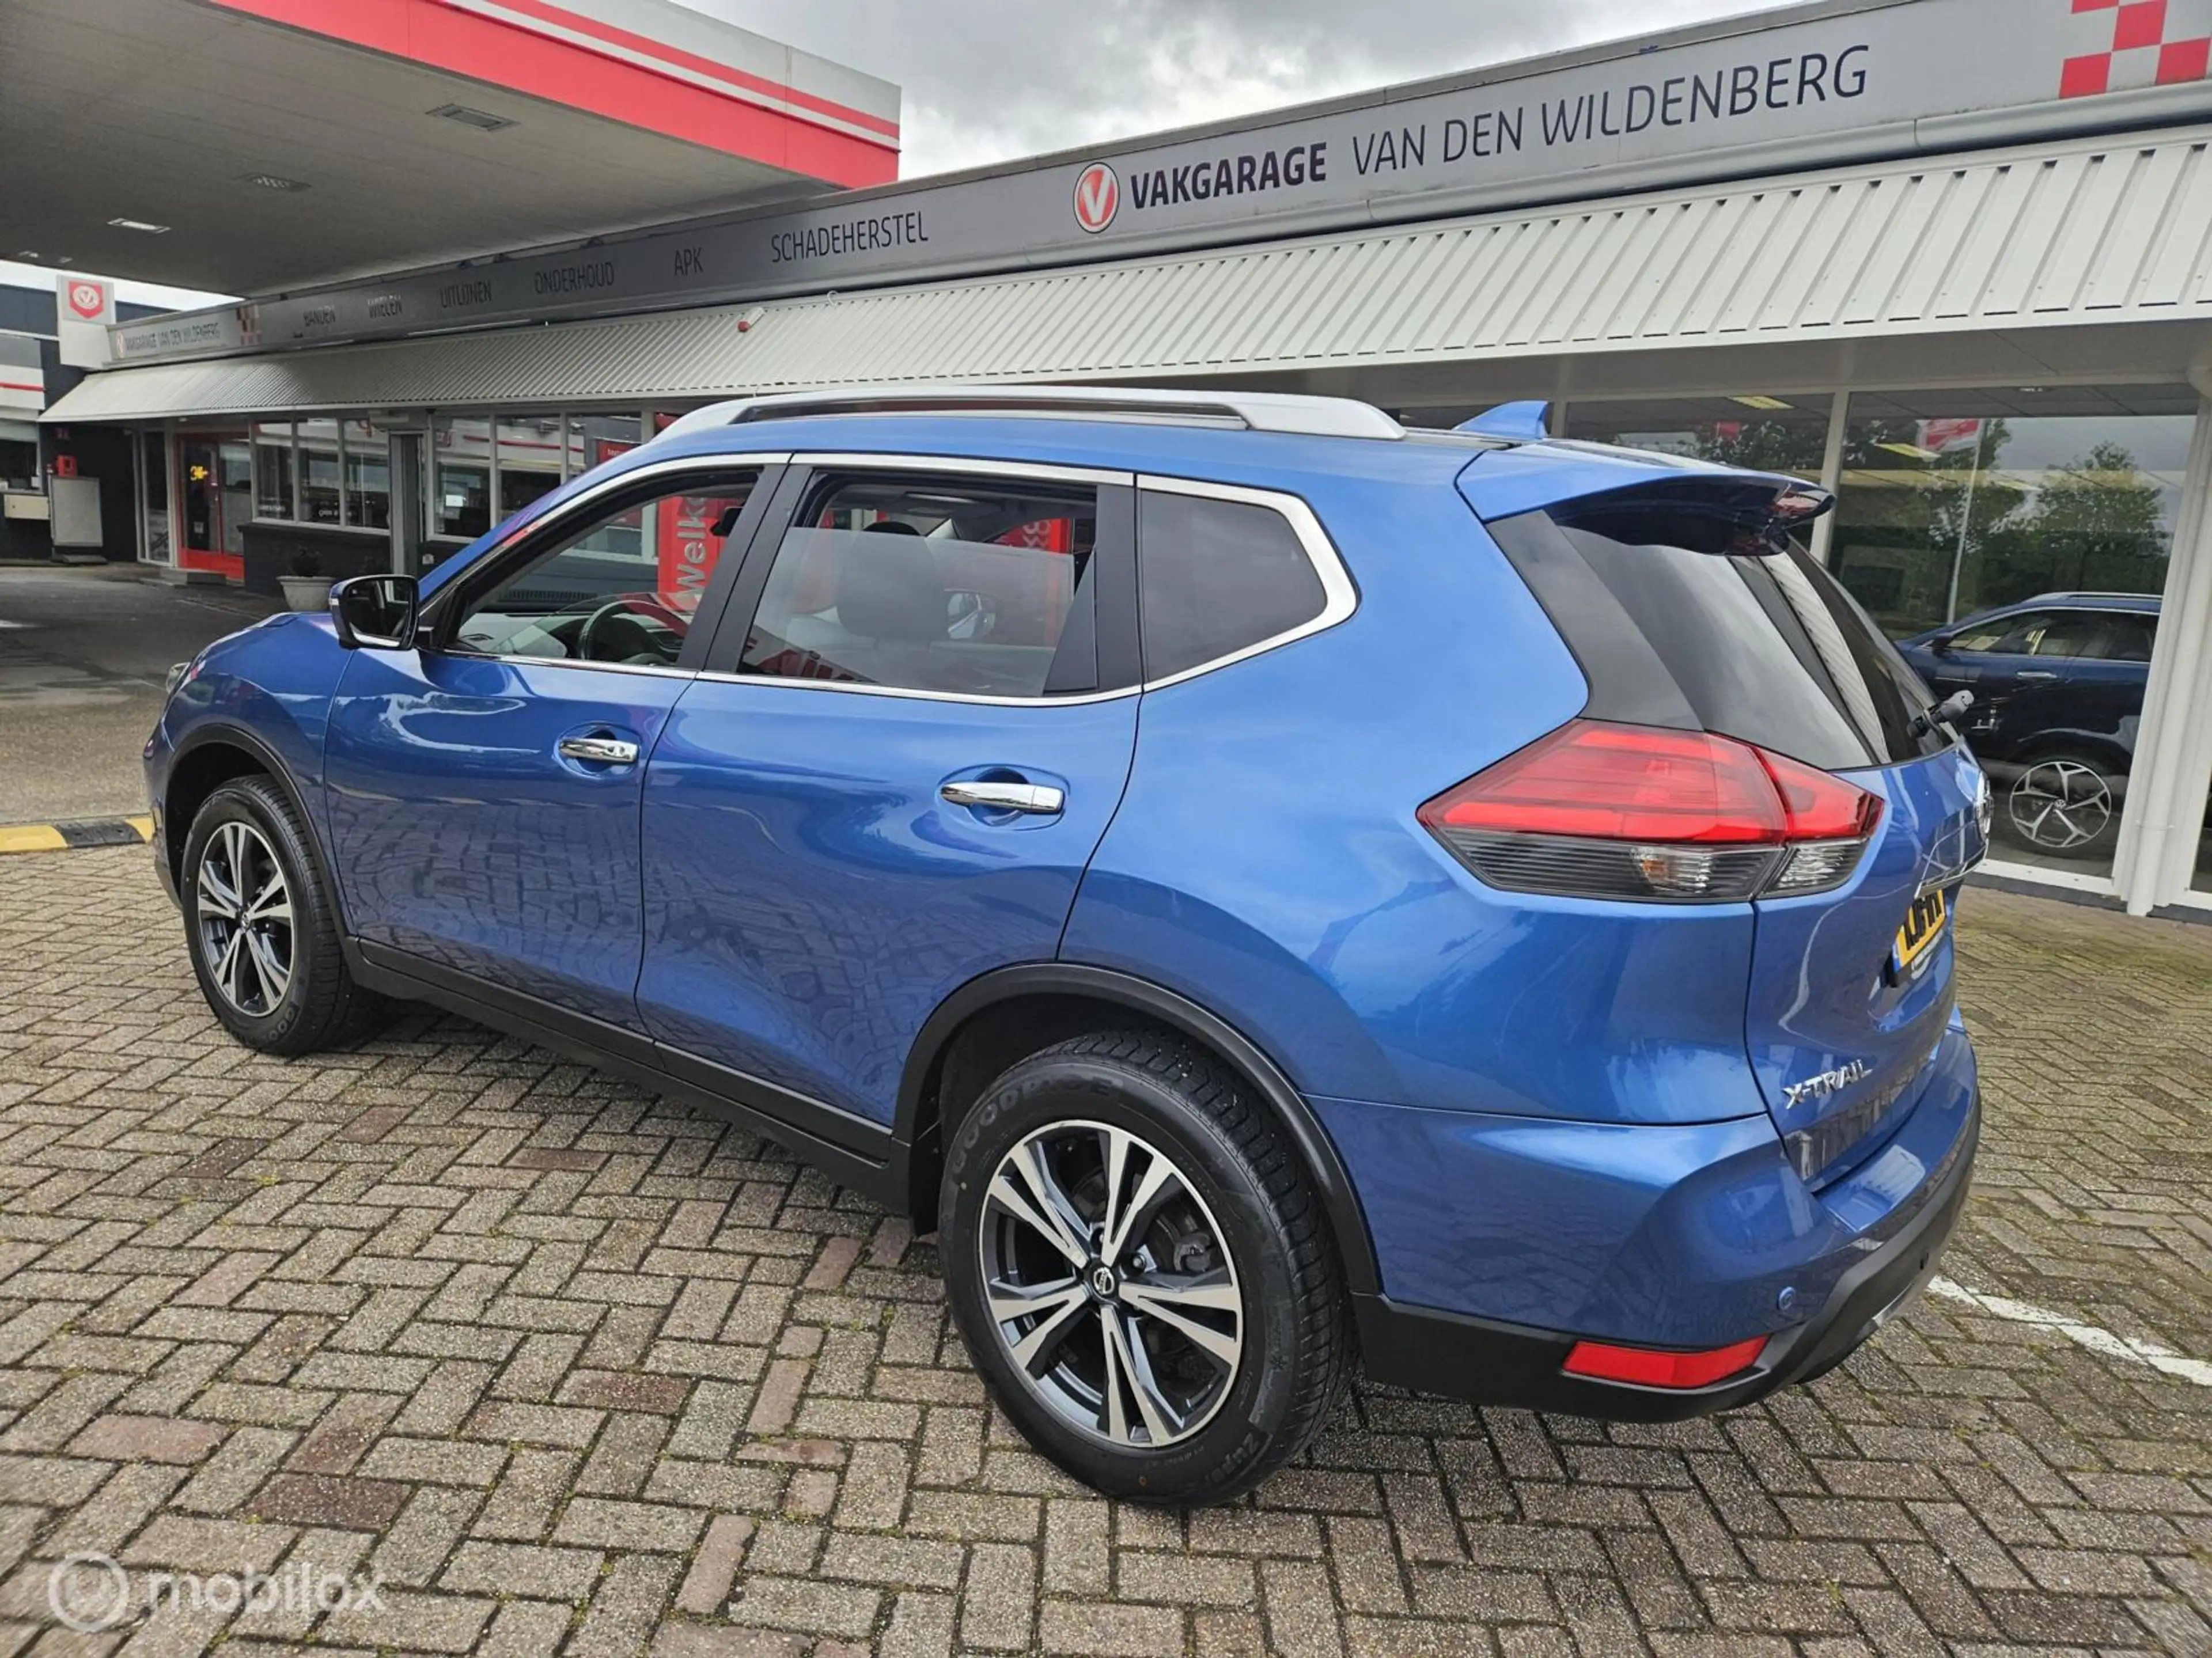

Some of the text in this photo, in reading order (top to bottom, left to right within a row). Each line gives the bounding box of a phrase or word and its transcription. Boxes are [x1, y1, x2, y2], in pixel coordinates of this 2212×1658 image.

[1131, 44, 1870, 210] VAKGARAGE VAN DEN WILDENBERG
[674, 248, 704, 276] APK
[771, 211, 929, 263] SCHADEHERSTEL
[534, 261, 615, 294] ONDERHOUD
[1782, 1058, 1873, 1110] X-TRAIL
